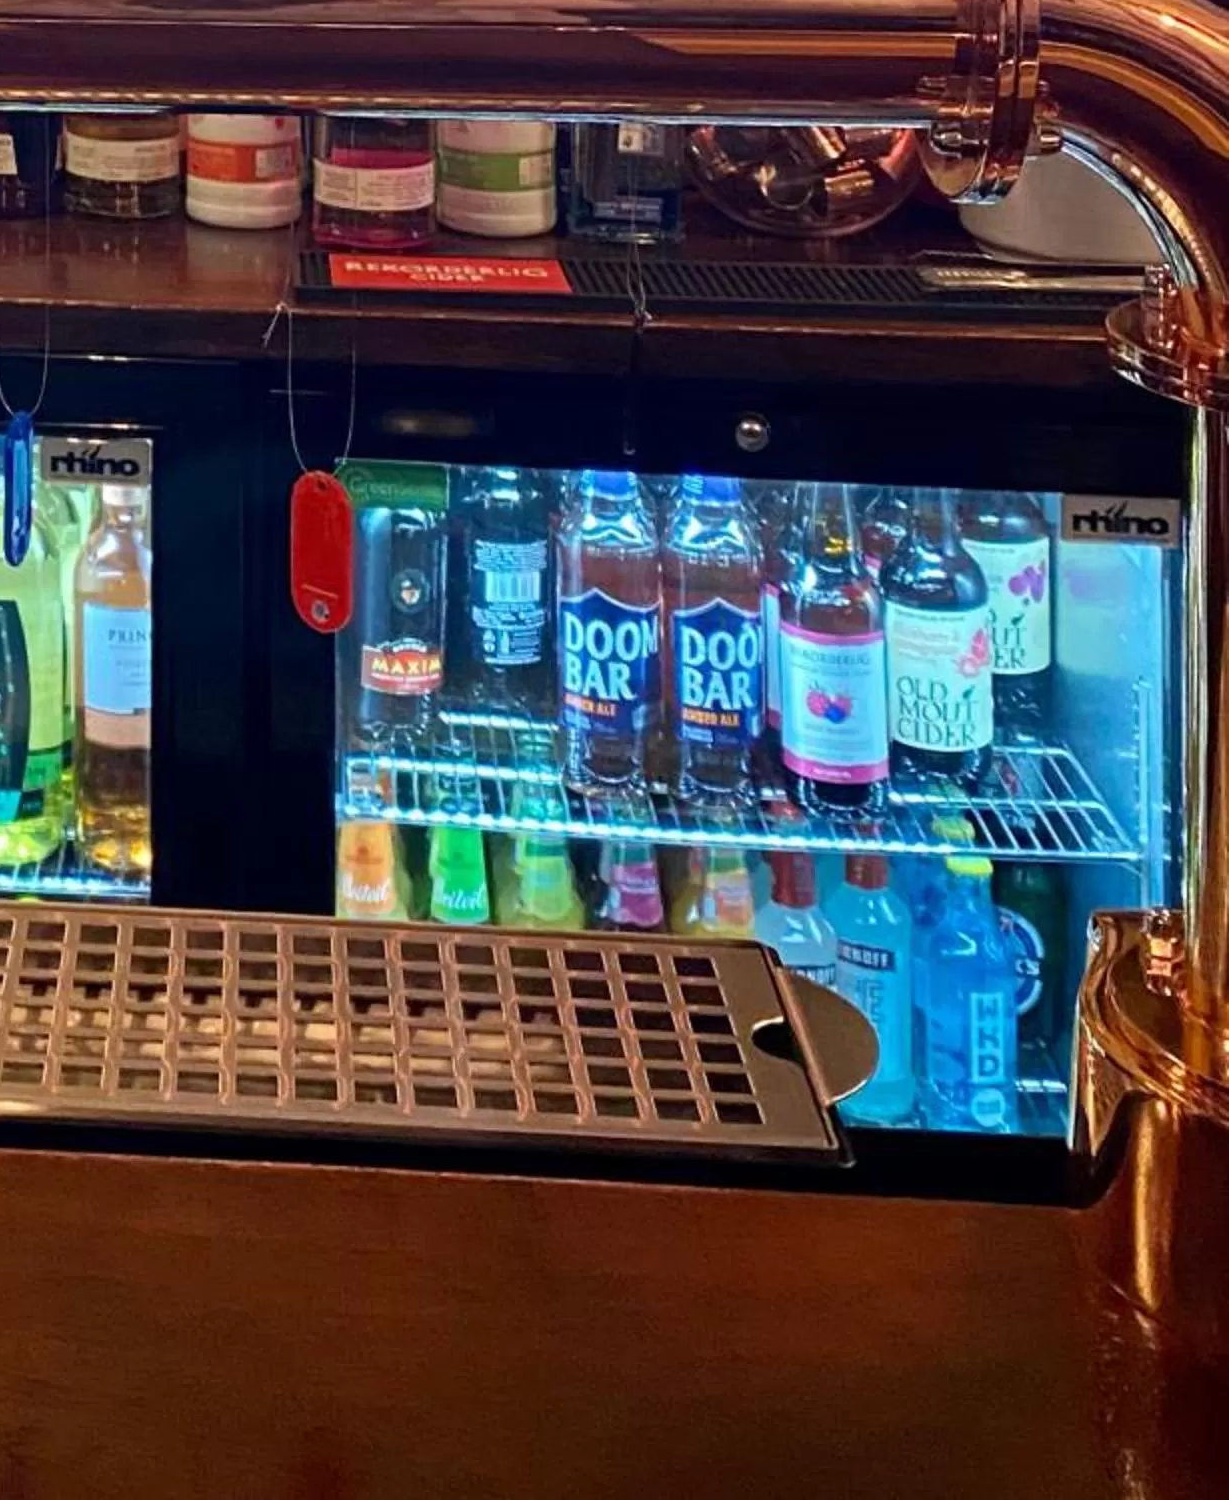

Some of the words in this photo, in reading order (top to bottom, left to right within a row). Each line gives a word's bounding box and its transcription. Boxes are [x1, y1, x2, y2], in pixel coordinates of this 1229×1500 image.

[344, 260, 549, 278] REKORDERLIG
[49, 445, 140, 476] rhino
[1072, 501, 1170, 535] rhino
[681, 622, 761, 672] DOO
[371, 655, 441, 676] MAXIM
[563, 651, 638, 701] BAR
[682, 665, 758, 710] BAR
[896, 675, 949, 701] OLD
[897, 695, 979, 723] MOUT
[896, 718, 977, 748] CIDER
[977, 997, 1001, 1077] WKD
